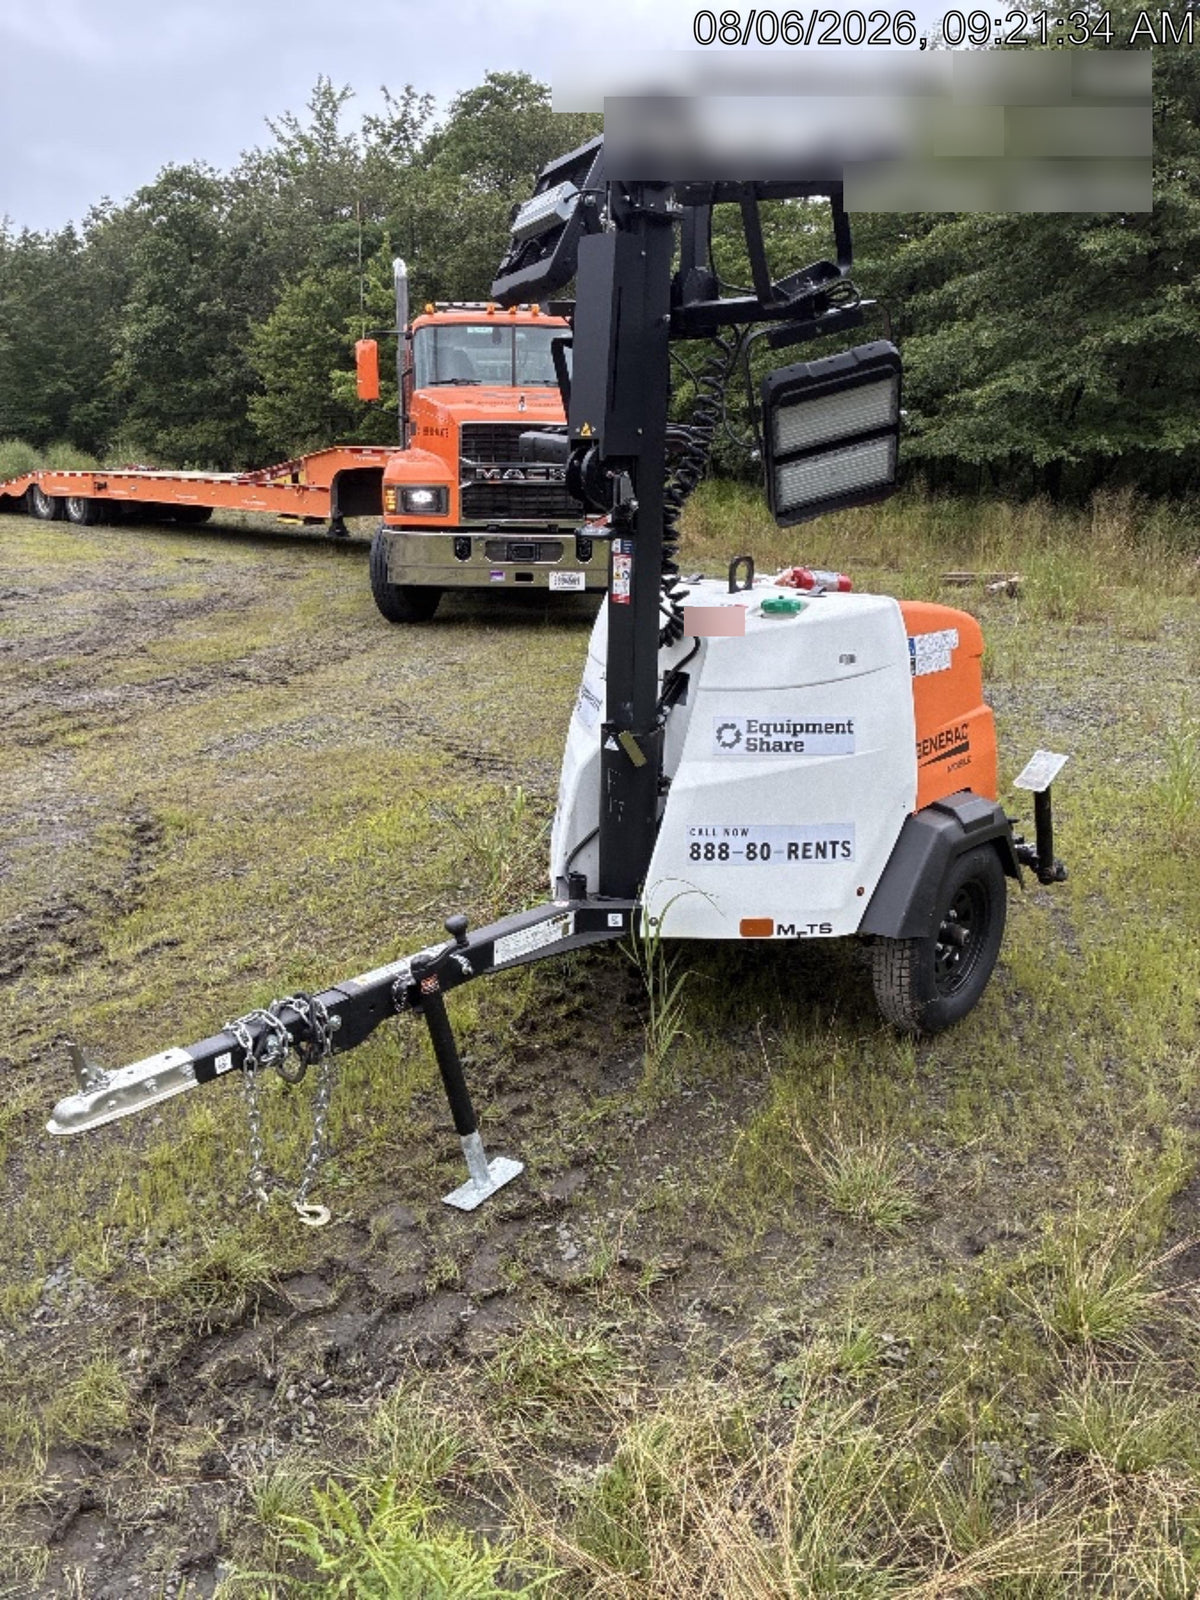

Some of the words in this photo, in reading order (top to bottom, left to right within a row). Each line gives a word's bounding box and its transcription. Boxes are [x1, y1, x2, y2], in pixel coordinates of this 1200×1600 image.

[745, 719, 854, 736] Equipment
[745, 737, 805, 753] Share
[689, 828, 716, 837] CALL
[723, 828, 750, 837] NOW
